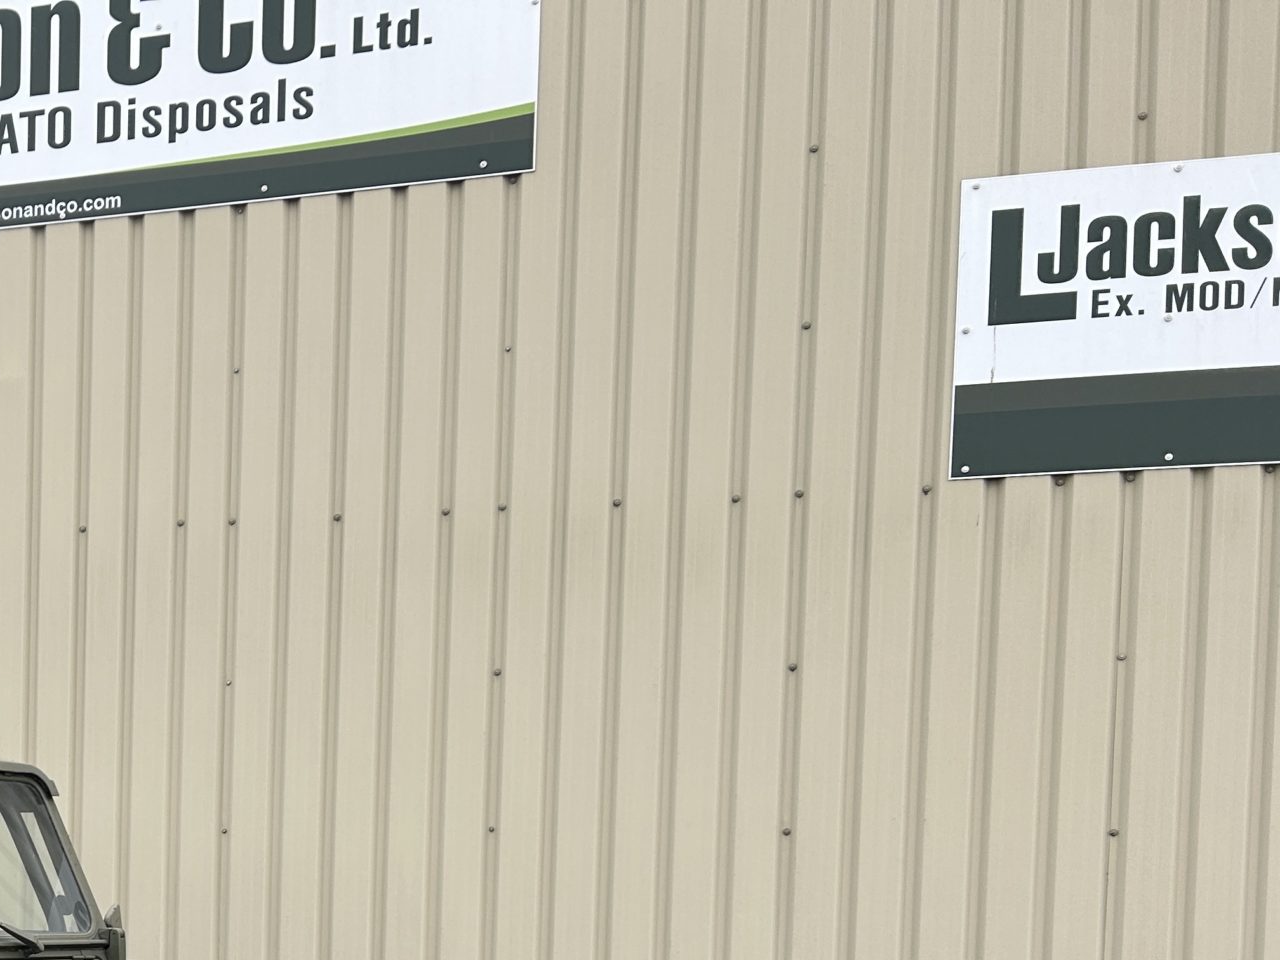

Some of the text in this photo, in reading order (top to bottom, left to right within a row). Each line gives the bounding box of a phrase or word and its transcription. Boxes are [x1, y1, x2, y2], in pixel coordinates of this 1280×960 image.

[107, 0, 171, 86] &
[198, 0, 337, 74] Co.
[353, 8, 434, 54] Ltd.
[96, 79, 314, 144] Disposals
[1091, 288, 1145, 319] Ex.
